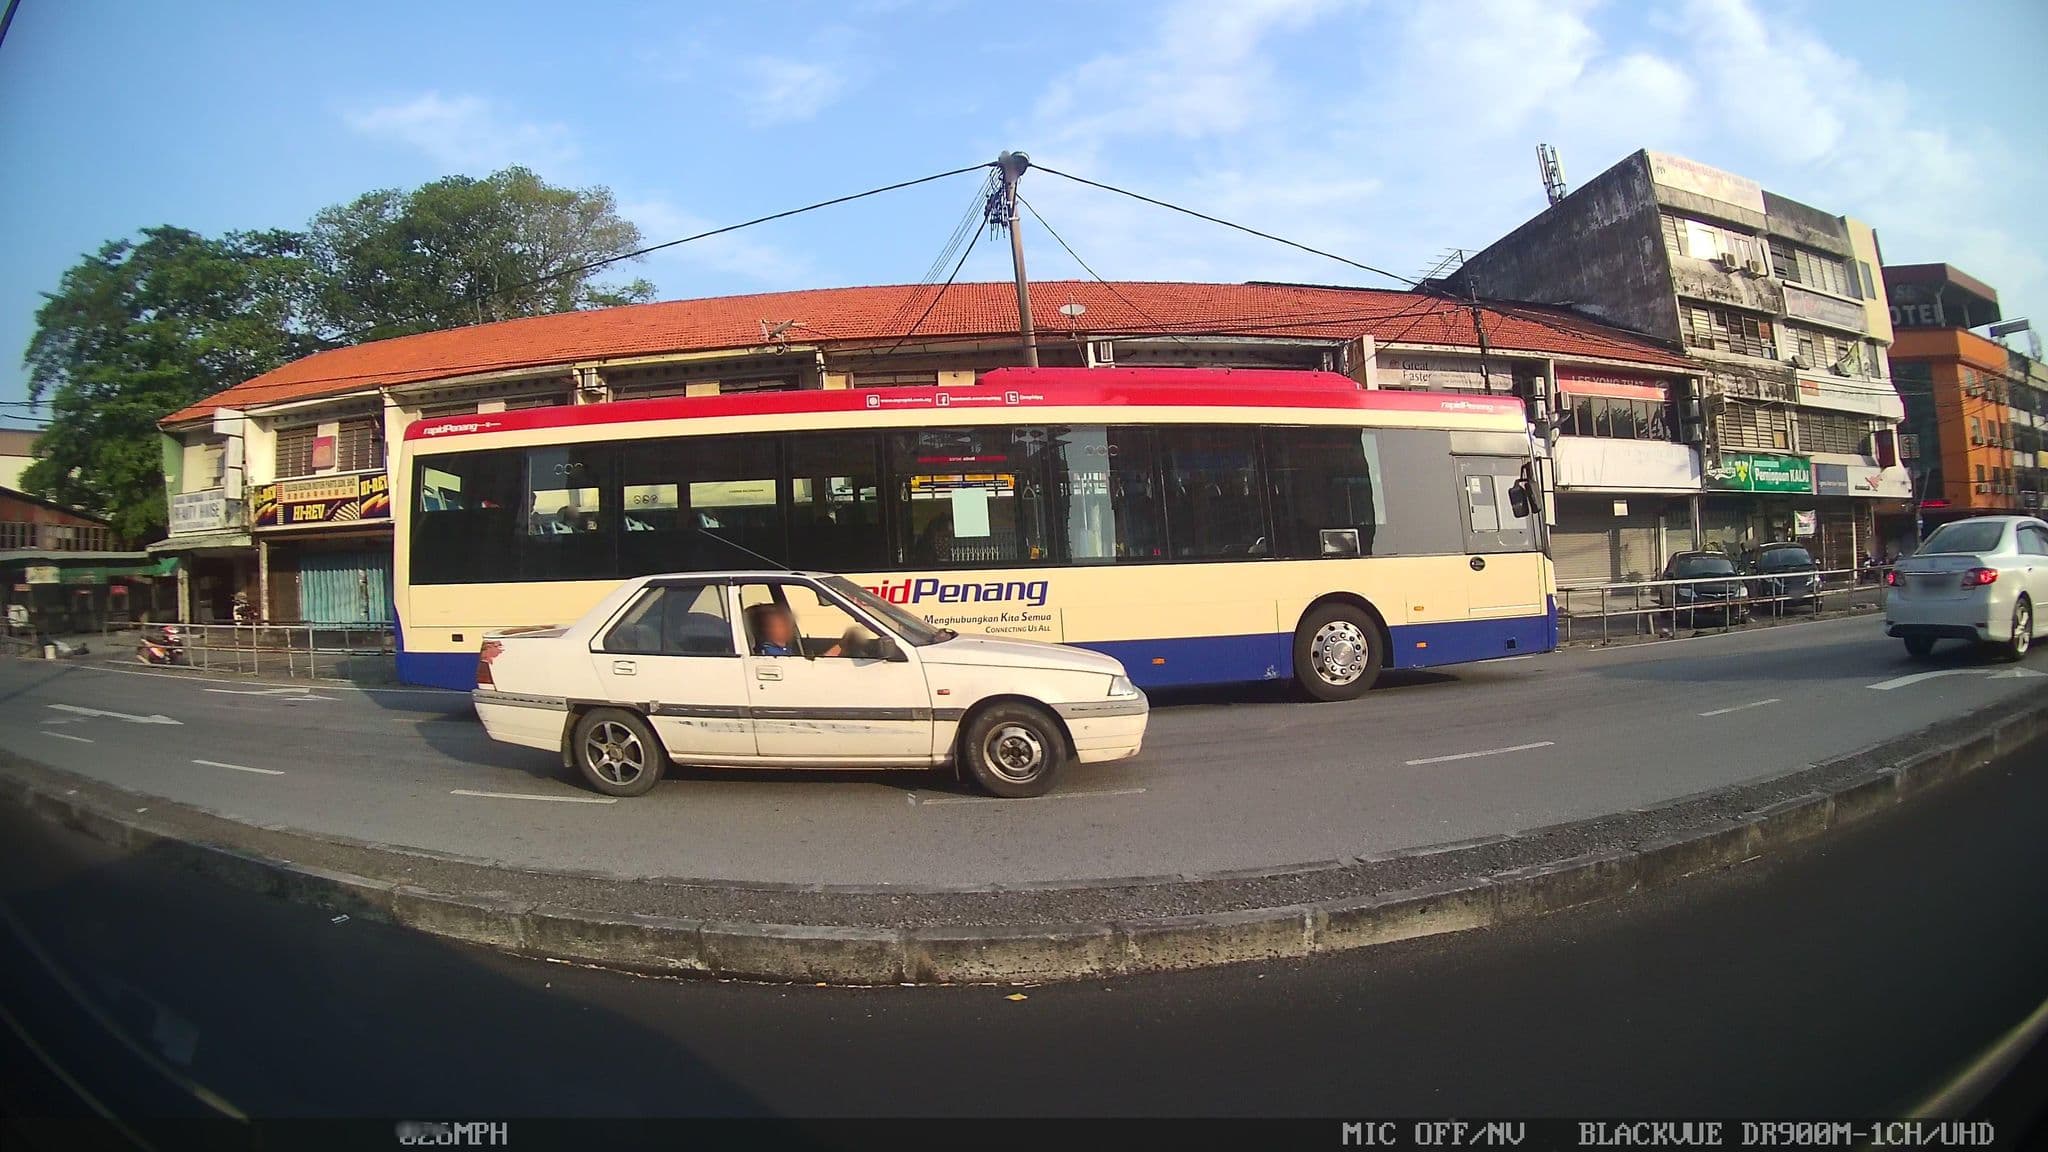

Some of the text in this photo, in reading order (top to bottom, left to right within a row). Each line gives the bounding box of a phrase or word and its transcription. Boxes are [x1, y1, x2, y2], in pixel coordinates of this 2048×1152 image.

[1402, 359, 1430, 371] Great
[1403, 370, 1433, 382] Easter
[423, 424, 478, 436] rapidPenang
[293, 504, 326, 521] HI-REV
[862, 577, 1049, 607] idPenang
[924, 610, 1052, 626] Menghubungkan Kita Semua
